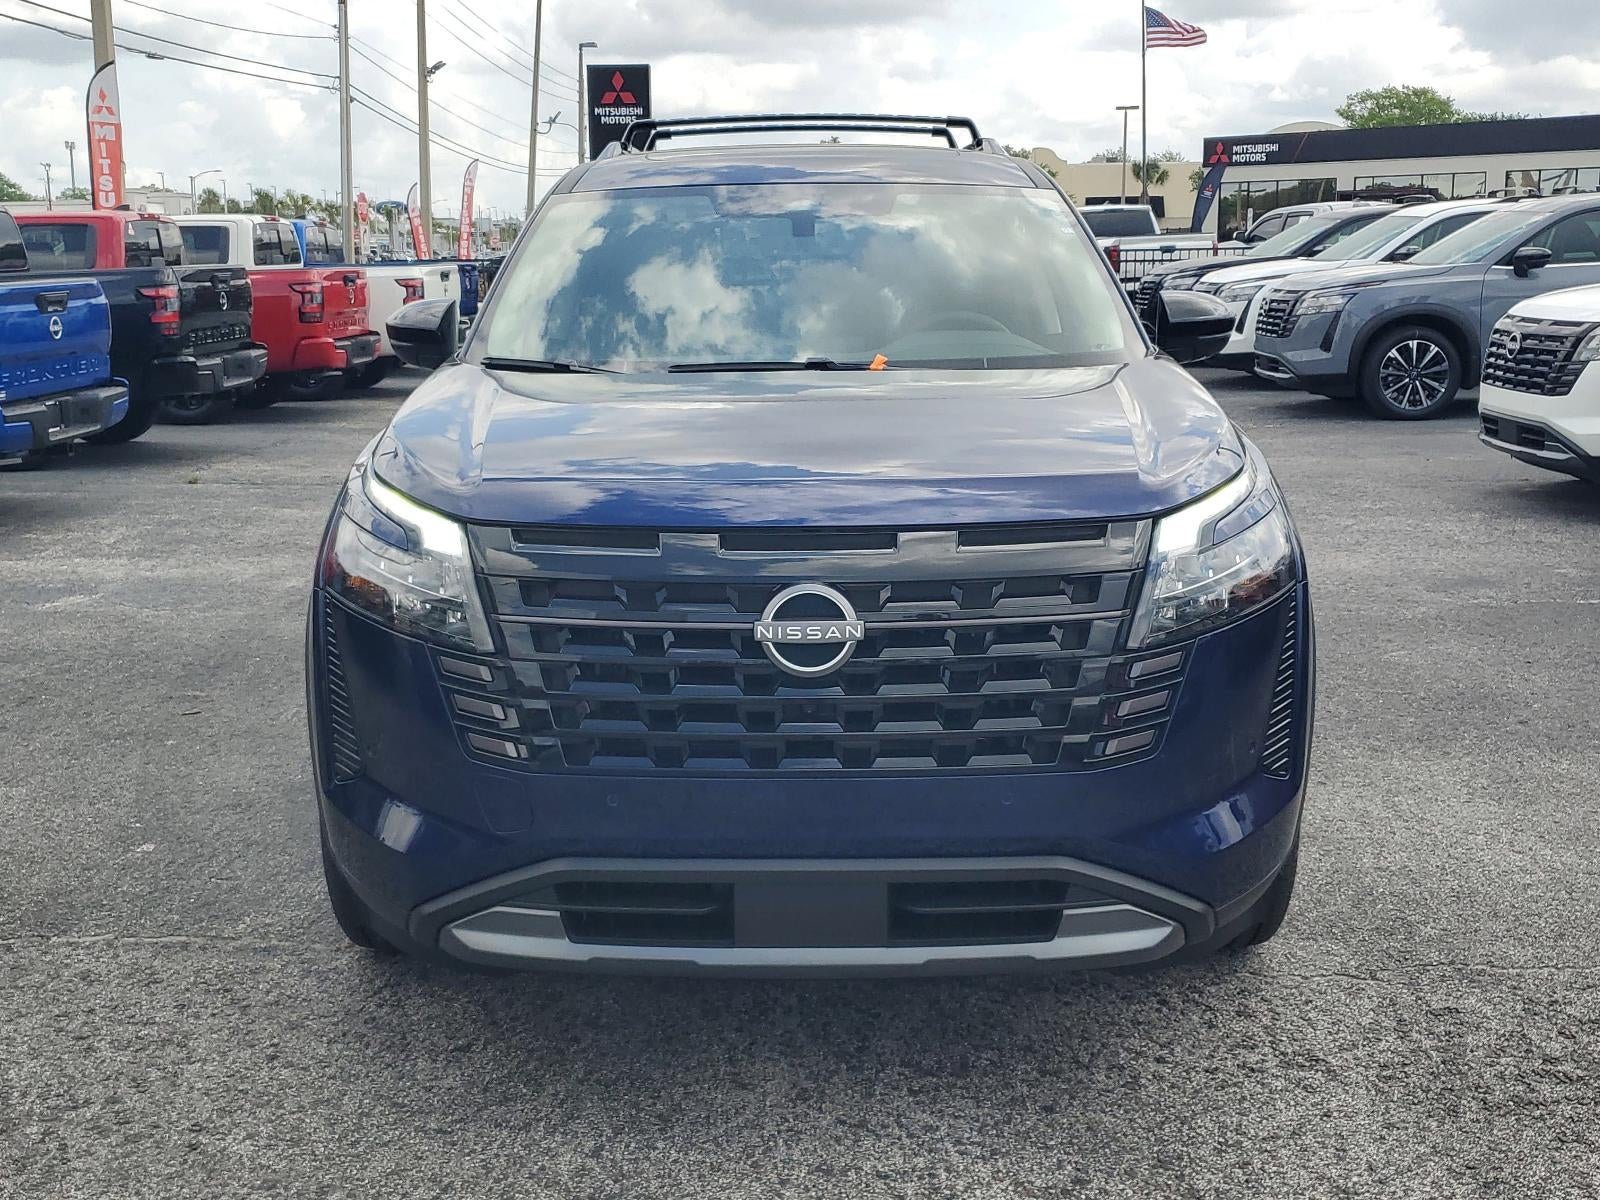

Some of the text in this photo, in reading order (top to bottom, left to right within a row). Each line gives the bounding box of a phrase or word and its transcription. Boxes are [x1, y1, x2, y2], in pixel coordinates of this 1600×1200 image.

[594, 107, 643, 116] MITSUBISHI
[601, 116, 637, 125] MOTORS
[1232, 144, 1279, 154] MITSUBISHI
[1232, 153, 1267, 163] MOTORS
[94, 123, 116, 208] MITSU
[757, 625, 862, 640] NISSAN
